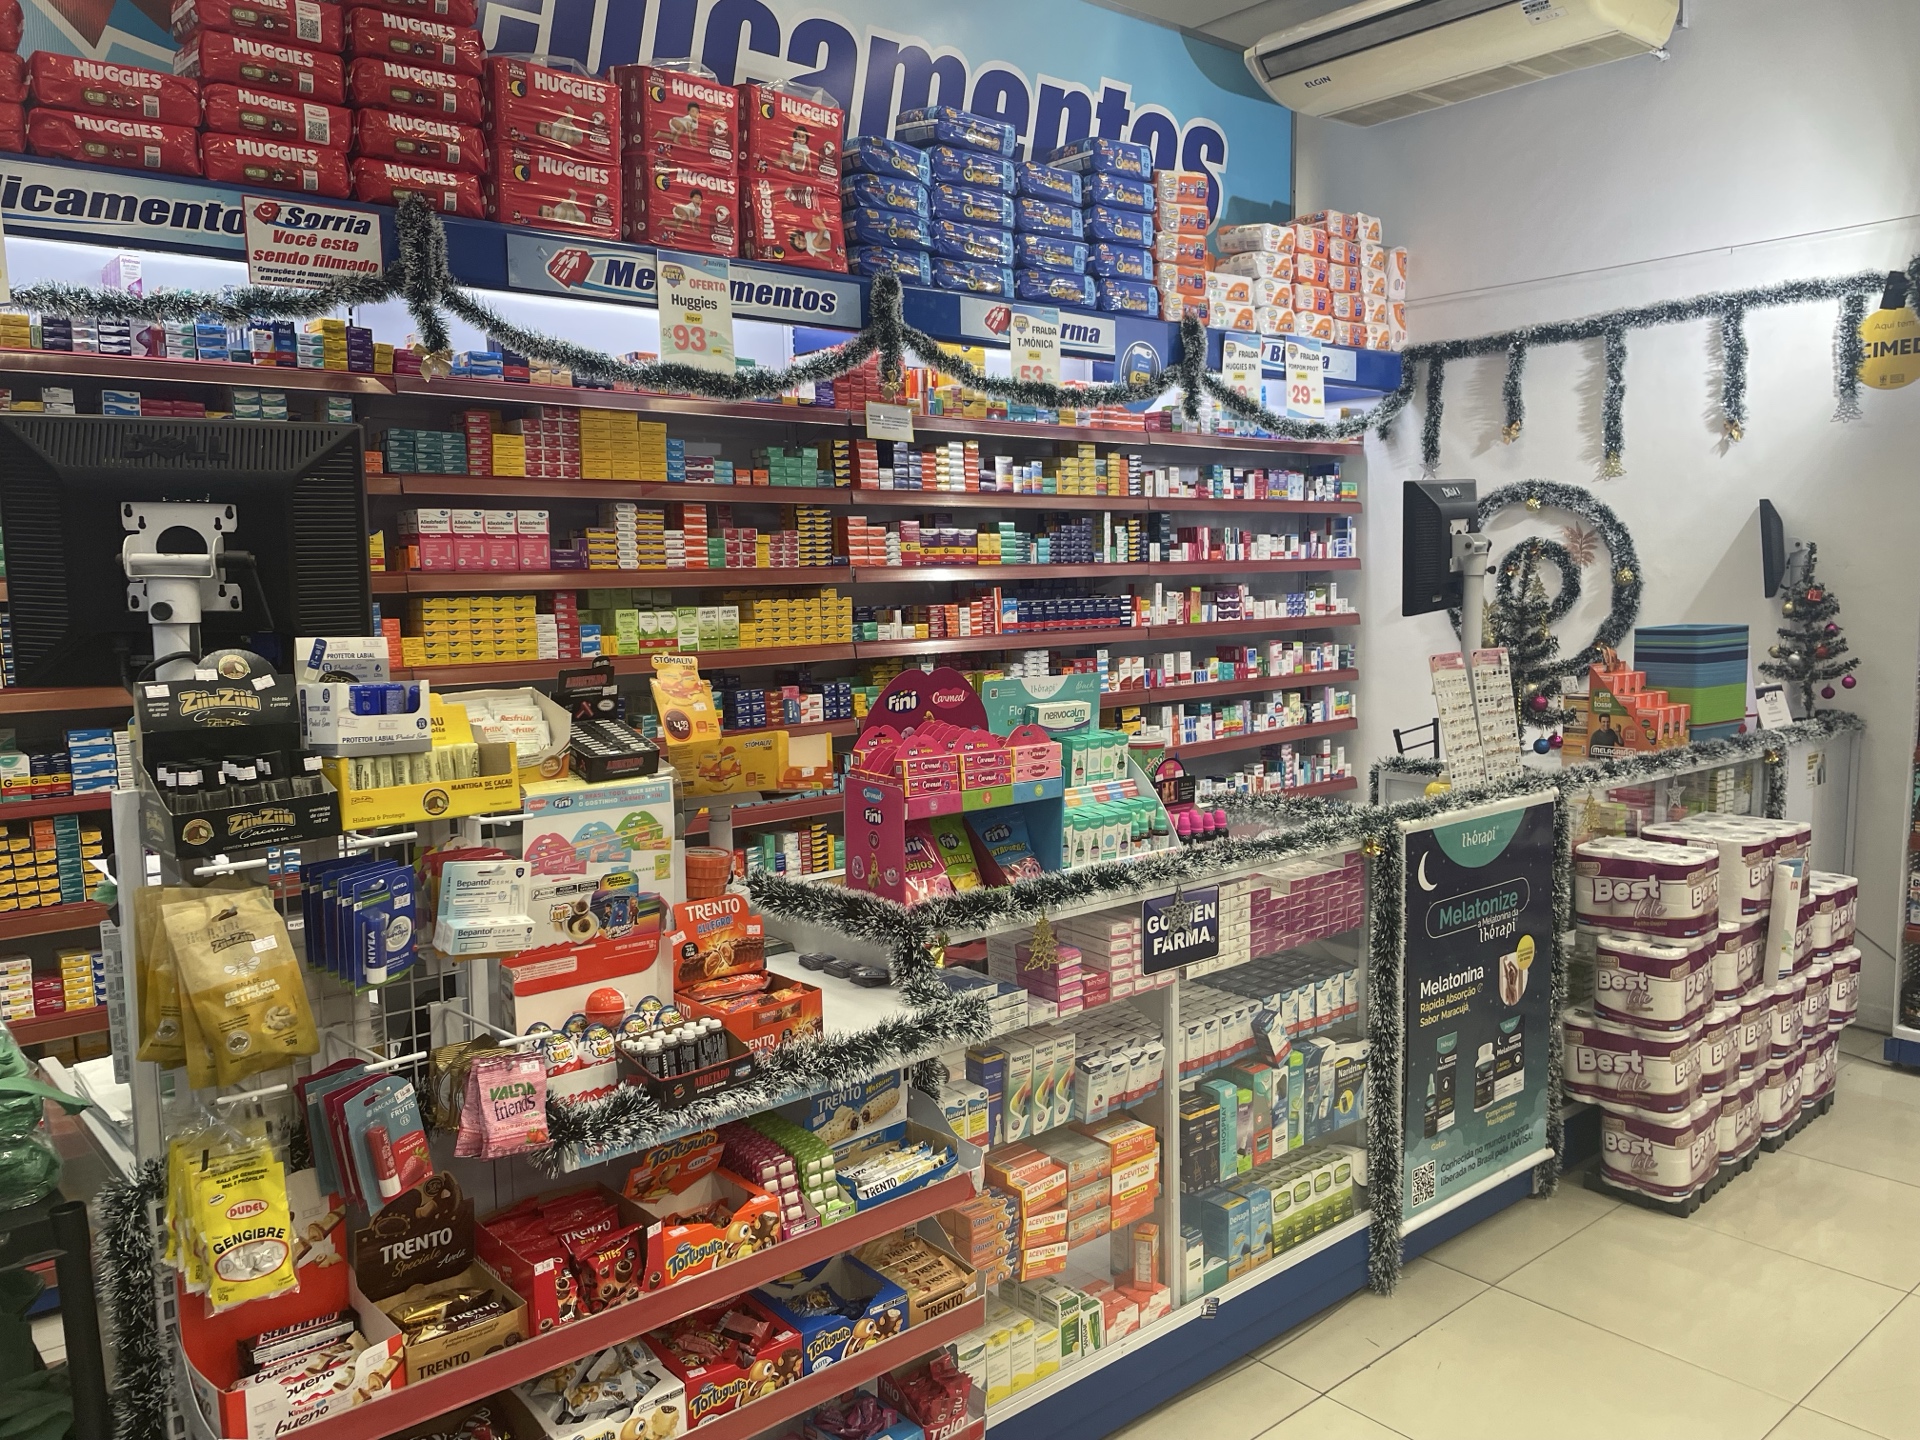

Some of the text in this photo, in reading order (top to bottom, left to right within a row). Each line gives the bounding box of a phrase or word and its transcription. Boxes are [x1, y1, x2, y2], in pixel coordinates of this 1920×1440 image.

[382, 13, 456, 40] HUGGIES
[233, 38, 314, 67] HUGGIES
[73, 59, 162, 89] HUGGIES
[384, 62, 456, 88] HUGGIES
[1304, 75, 1332, 89] ELGIN
[534, 71, 606, 103] HUGGIES
[672, 79, 734, 108] HUGGIES
[238, 89, 297, 113] HUGGIES
[781, 97, 839, 127] HUGGIES
[73, 115, 163, 139] HUGGIES
[388, 113, 460, 139] HUGGIES
[236, 139, 318, 164] HUGGIES
[384, 164, 457, 186] HUGGIES
[538, 156, 609, 185] HUGGIES
[676, 168, 735, 195] HUGGIES
[0, 174, 245, 235] icamento
[759, 179, 776, 240] HUGGIES
[285, 207, 371, 235] Sorria
[273, 230, 359, 252] Você esta
[253, 250, 379, 273] sendo filmado
[273, 276, 294, 284] poder
[689, 278, 727, 292] OFERTA
[671, 293, 718, 311] Huggies
[1032, 326, 1057, 336] FRALDA
[1874, 320, 1915, 331] Aqui tem
[673, 324, 707, 352] 93
[1017, 337, 1053, 349] T.MÔNICA
[1238, 350, 1259, 359] FRALDA
[1300, 352, 1320, 361] FRALDA
[1226, 363, 1248, 371] HUGGIES
[1292, 384, 1311, 405] 29
[653, 656, 693, 665] STOMALIV
[180, 688, 261, 716] ZiinZiin
[888, 690, 917, 711] Fini
[932, 690, 966, 704] Carmed
[342, 736, 374, 744] PROTETOR
[451, 777, 513, 791] MANTEIGA DE CACAU
[584, 792, 607, 800] BRASIL
[608, 790, 627, 798] TODO
[554, 797, 573, 808] Fini
[584, 798, 618, 807] GOSTINHO
[619, 795, 645, 803] CARMED
[228, 808, 296, 837] ZiinZiin
[352, 815, 375, 824] Hidrata
[382, 812, 406, 821] Protege
[864, 809, 882, 823] Fini
[985, 824, 1010, 842] Fini
[393, 882, 408, 890] NIVEA
[457, 879, 492, 888] Bepantol
[1593, 873, 1661, 904] Best
[1692, 873, 1718, 910] Best
[685, 898, 741, 923] TRENTO
[1147, 901, 1216, 934] GOEN
[1439, 890, 1518, 930] Melatonize
[1482, 911, 1512, 927] Melatonina
[1511, 909, 1519, 917] da
[458, 927, 493, 937] Bepantol
[697, 915, 734, 935] ALLEGRO!
[368, 930, 376, 964] NIVEA
[1153, 926, 1210, 956] FARMA
[1420, 965, 1484, 999] Melatonina
[1598, 971, 1649, 992] Best
[1420, 985, 1476, 1014] Rápida Absorção
[1420, 1003, 1469, 1028] Sabor Maracujá
[1577, 1047, 1645, 1075] Best
[694, 1069, 730, 1087] ARRETADO
[489, 1082, 537, 1101] VALDA
[817, 1086, 862, 1113] TRENTO
[390, 1101, 415, 1119] FRUTIS
[494, 1094, 536, 1122] friends
[1485, 1101, 1518, 1120] Comprimidos
[398, 1137, 424, 1155] MORANGO
[648, 1131, 719, 1166] Tortuguita
[1116, 1135, 1144, 1150] ACEVITON
[1430, 1140, 1447, 1151] Gotas
[1440, 1154, 1474, 1173] Conhecida
[1483, 1134, 1507, 1151] mundo
[1511, 1123, 1530, 1137] agora
[1604, 1131, 1653, 1157] Best
[1440, 1166, 1467, 1186] liberada
[1477, 1153, 1494, 1169] Brasil
[1494, 1146, 1509, 1161] pela
[1509, 1131, 1534, 1150] ANVISA!
[1011, 1163, 1041, 1181] ACEVITON
[1118, 1163, 1150, 1182] ACEVITON
[863, 1177, 898, 1199] TRENTO
[1027, 1178, 1055, 1197] ACEVITON
[229, 1202, 265, 1217] DUDEL
[1028, 1215, 1056, 1227] ACEVITON
[213, 1227, 286, 1254] GENGIBRE
[380, 1227, 453, 1265] TRENTO
[392, 1249, 441, 1278] Speciale
[598, 1248, 621, 1263] BITES
[666, 1240, 724, 1279] Tortuguita
[1028, 1246, 1056, 1259] ACEVITON
[924, 1294, 963, 1321] TRENTO
[807, 1325, 852, 1359] Tortuguita
[254, 1356, 308, 1384] bueno
[417, 1350, 471, 1381] TRENTO
[690, 1378, 748, 1418] Tortuguita
[274, 1405, 330, 1436] bueno
[288, 1406, 315, 1418] Kinder
